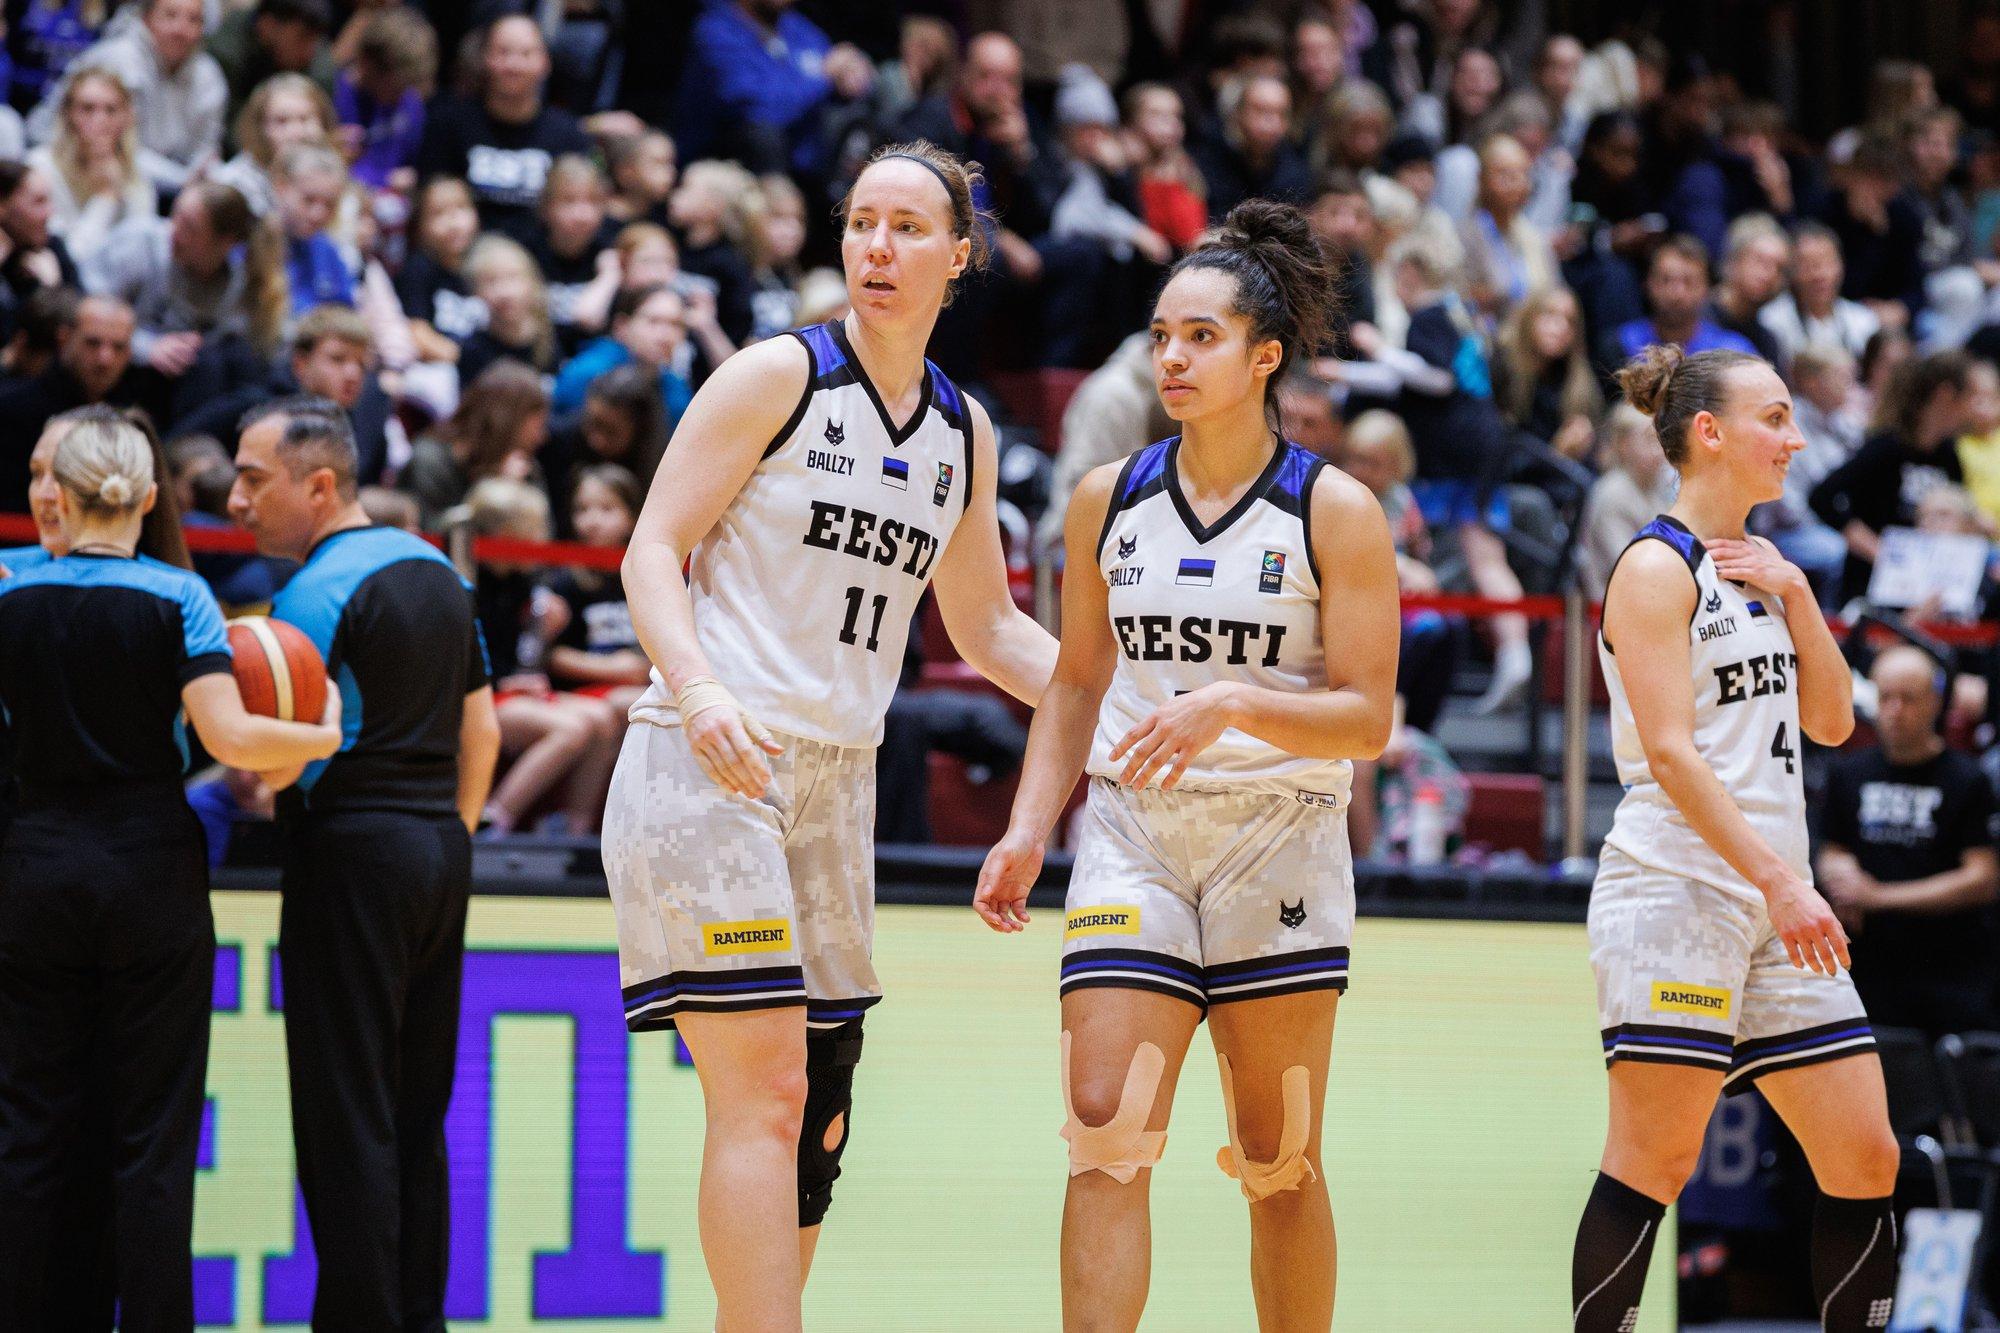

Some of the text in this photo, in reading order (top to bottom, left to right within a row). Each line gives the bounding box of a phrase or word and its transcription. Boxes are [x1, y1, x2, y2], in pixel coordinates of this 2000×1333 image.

[807, 450, 855, 476] BALLZY
[803, 500, 939, 581] EESTI
[1263, 574, 1279, 584] FIBA
[839, 586, 888, 653] 11
[1699, 617, 1738, 642] BALLZY
[1114, 615, 1287, 668] EESTI
[1771, 721, 1794, 774] 4
[1068, 914, 1128, 931] RAMIRENT
[713, 929, 784, 945] RAMIRENT
[1660, 991, 1724, 1009] RAMIRENT
